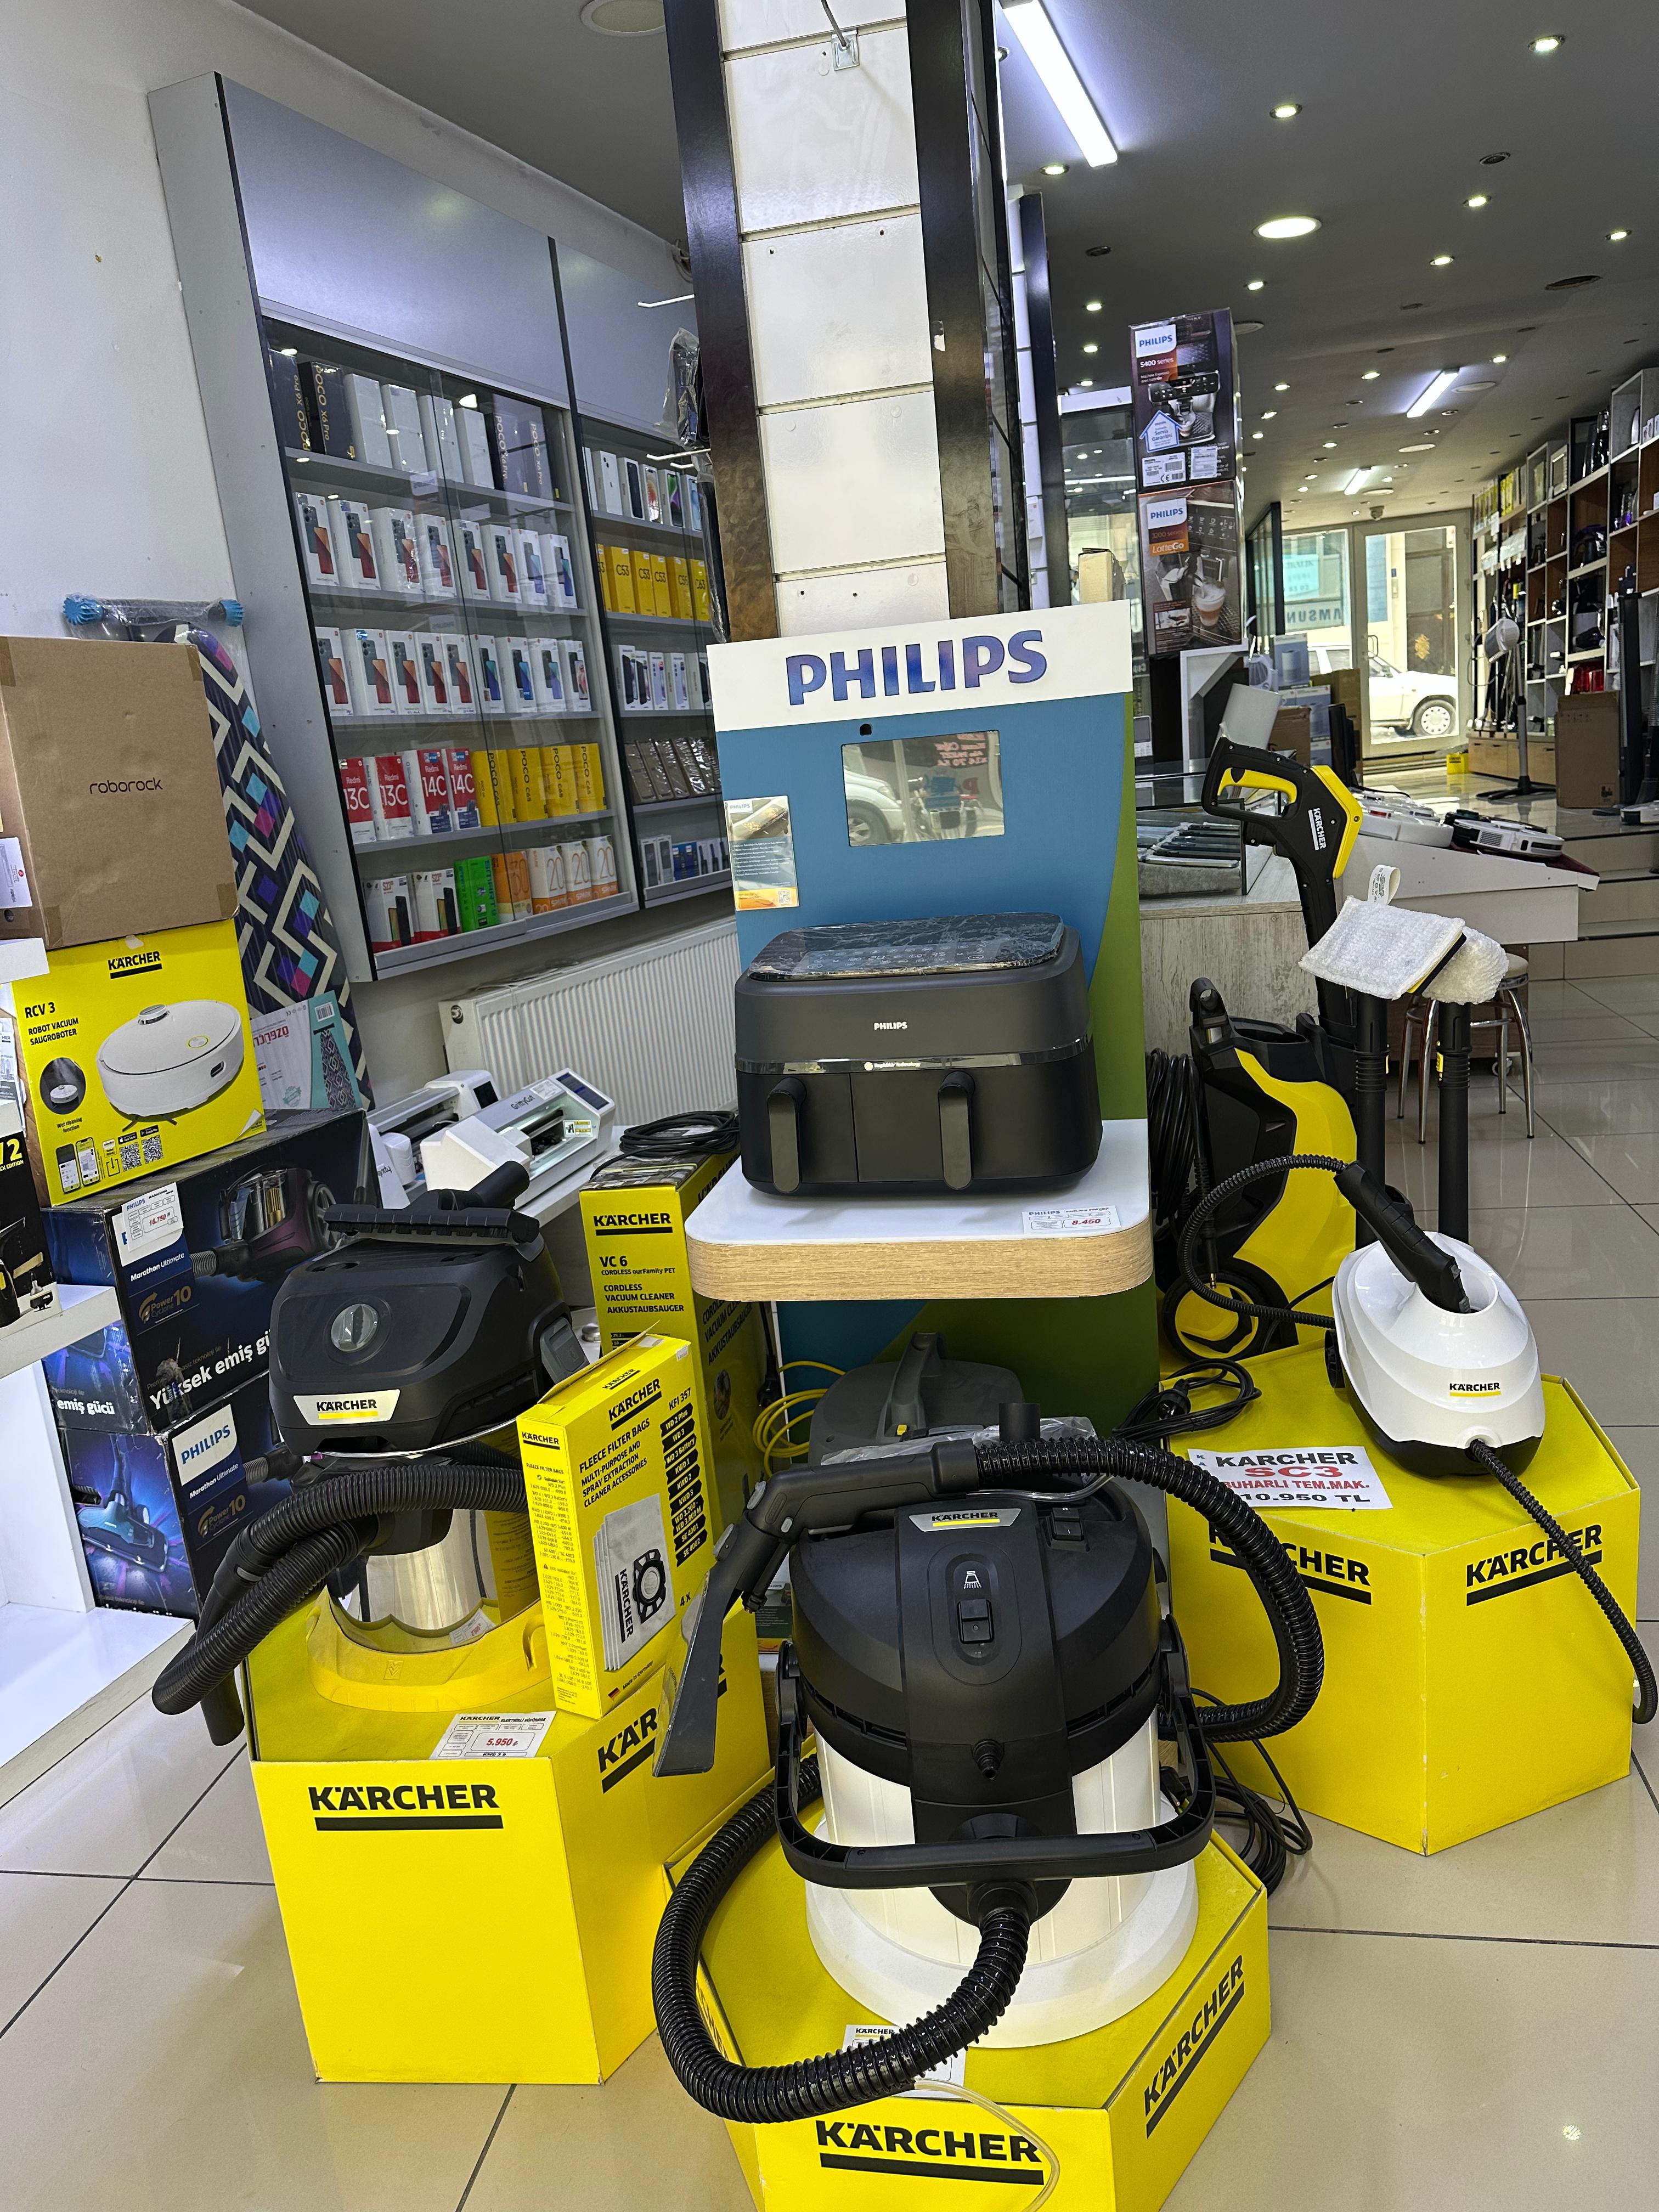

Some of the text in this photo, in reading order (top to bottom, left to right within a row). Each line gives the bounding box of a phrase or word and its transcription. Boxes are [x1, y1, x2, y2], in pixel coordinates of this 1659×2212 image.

[1139, 335, 1173, 347] PHILIPS
[295, 393, 303, 405] X6
[315, 365, 326, 406] POCO
[321, 410, 328, 422] X6
[297, 410, 312, 450] POCO
[495, 416, 506, 450] POCO
[531, 424, 540, 456] POCO
[1150, 508, 1183, 520] PHILIPS
[1153, 542, 1184, 554] LatteGo
[616, 565, 629, 576] C53
[639, 568, 650, 580] C53
[654, 572, 666, 583] C53
[786, 629, 1047, 707] PHILIPS
[488, 753, 498, 787] POCO
[521, 751, 529, 783] POCO
[553, 748, 561, 780] POCO
[581, 746, 589, 777] POCO
[89, 777, 163, 794] roborock
[422, 776, 446, 797] 14C
[450, 774, 475, 794] 14C
[343, 788, 370, 810] 13C
[380, 784, 408, 806] 13C
[1313, 808, 1327, 849] KÄRCHER
[572, 851, 589, 885] 20
[597, 846, 614, 878] 20
[547, 857, 564, 891] 20
[108, 951, 161, 970] KÄRCHER
[25, 1002, 55, 1019] RCV 3
[28, 1017, 79, 1035] ROBOT VACUUM
[253, 1025, 289, 1047] ÖZGÜÇL
[874, 1022, 908, 1030] PHILIPS
[30, 1029, 77, 1046] SAUGROBOTER
[511, 1094, 535, 1110] GrittyCut
[63, 1125, 80, 1133] function
[65, 1117, 83, 1126] cleaning
[7, 1160, 24, 1170] EDITION
[127, 1198, 145, 1211] PHILIPS
[149, 1214, 166, 1226] 16.750
[593, 1212, 672, 1227] KÄRCHER
[131, 1252, 185, 1282] Marathon Ultimate
[600, 1256, 628, 1267] VC 6
[151, 1285, 191, 1310] Power 10
[151, 1304, 174, 1318] Cyclone
[607, 1305, 684, 1313] AKKUSTAUBSAUGER
[704, 1312, 727, 1342] VACUUM
[215, 1345, 252, 1374] emiş
[602, 1369, 636, 1390] KÄRCHER
[1449, 1381, 1500, 1393] KÄRCHER
[57, 1398, 115, 1415] emiş gücü
[316, 1399, 377, 1412] KÄRCHER
[608, 1378, 661, 1421] KÄRCHER
[669, 1387, 691, 1410] KFI 357
[665, 1420, 674, 1430] WD
[678, 1409, 688, 1421] Plus
[181, 1425, 230, 1464] PHILIPS
[522, 1431, 560, 1444] KÄRCHER
[579, 1418, 650, 1474] FLEECE FILTER BAGS
[672, 1432, 681, 1442] WD
[666, 1454, 675, 1464] WD
[679, 1437, 695, 1453] Battery
[1215, 1452, 1359, 1467] KARCHER
[581, 1440, 641, 1487] MULTI-PURPOSE AND
[675, 1462, 686, 1475] KWD
[1244, 1466, 1343, 1478] SC3
[190, 1463, 239, 1499] Marathon Ultimate
[583, 1453, 639, 1498] SPRAY EXTRACTION
[584, 1485, 611, 1508] CLEANER
[612, 1458, 648, 1488] ACCESSORIES
[676, 1477, 689, 1490] KWD
[1292, 1480, 1370, 1489] TEM.MAK.
[679, 1493, 690, 1506] KWD
[1240, 1493, 1370, 1503] 10.950 TL
[208, 1494, 246, 1523] Power 10
[675, 1522, 685, 1532] WD
[696, 1505, 701, 1514] M
[932, 1511, 999, 1522] KÄRCHER
[675, 1514, 684, 1524] WD
[681, 1523, 699, 1542] SE 4001
[683, 1538, 701, 1558] SE 4002
[1209, 1522, 1372, 1587] KCHER
[1466, 1523, 1603, 1587] KÄRCHER
[620, 1568, 634, 1639] KÄRCHER
[680, 1592, 691, 1607] 4 x
[623, 1678, 633, 1690] Made
[637, 1660, 653, 1677] Germany
[487, 1738, 514, 1746] 5.950
[309, 1784, 499, 1812] KÄRCHER
[855, 2027, 894, 2035] KÄRCHER
[1144, 1955, 1244, 2118] KÄRCHER
[816, 2119, 1042, 2163] KÄRCHER
